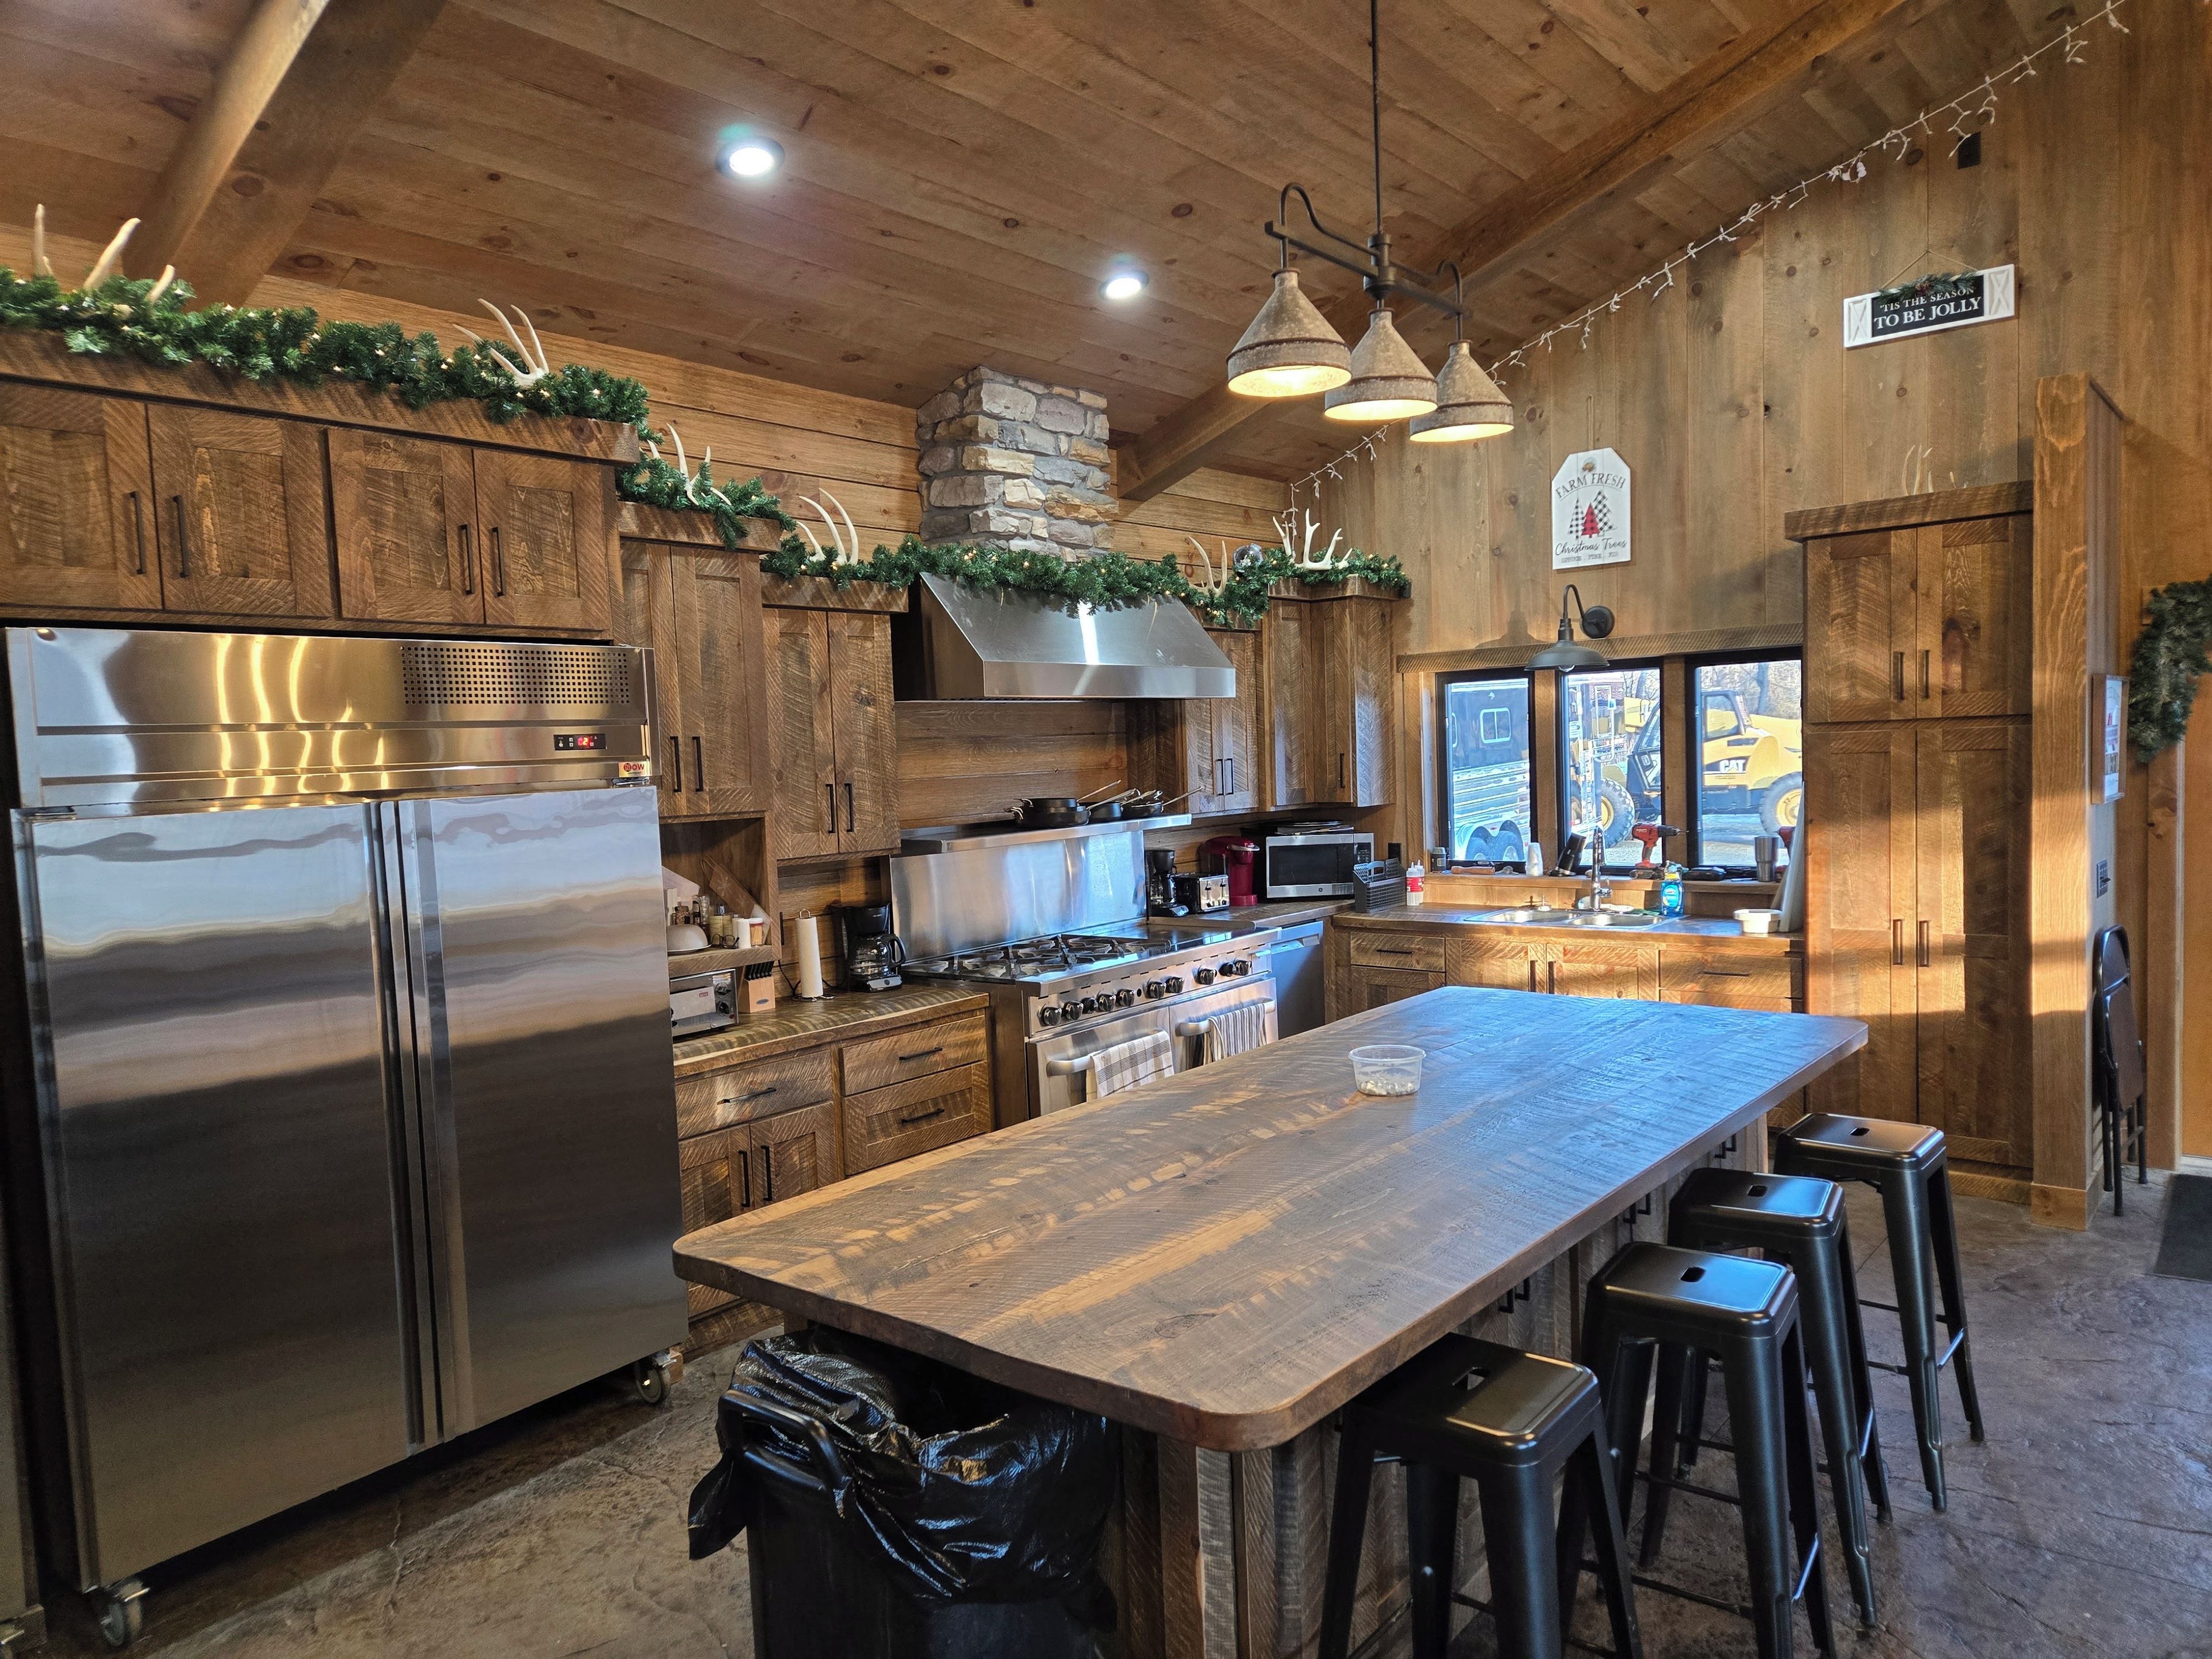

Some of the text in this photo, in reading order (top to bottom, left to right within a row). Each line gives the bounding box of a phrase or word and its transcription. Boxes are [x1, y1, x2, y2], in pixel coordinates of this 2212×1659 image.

[1903, 296, 1927, 307] THE
[1930, 287, 1976, 302] SEASON
[1874, 296, 1981, 329] TO BE JOLLY
[1555, 473, 1626, 498] FARM FRESH
[1555, 537, 1627, 555] Christmas Trees
[624, 763, 645, 772] NOW
[1719, 760, 1745, 772] CAT
